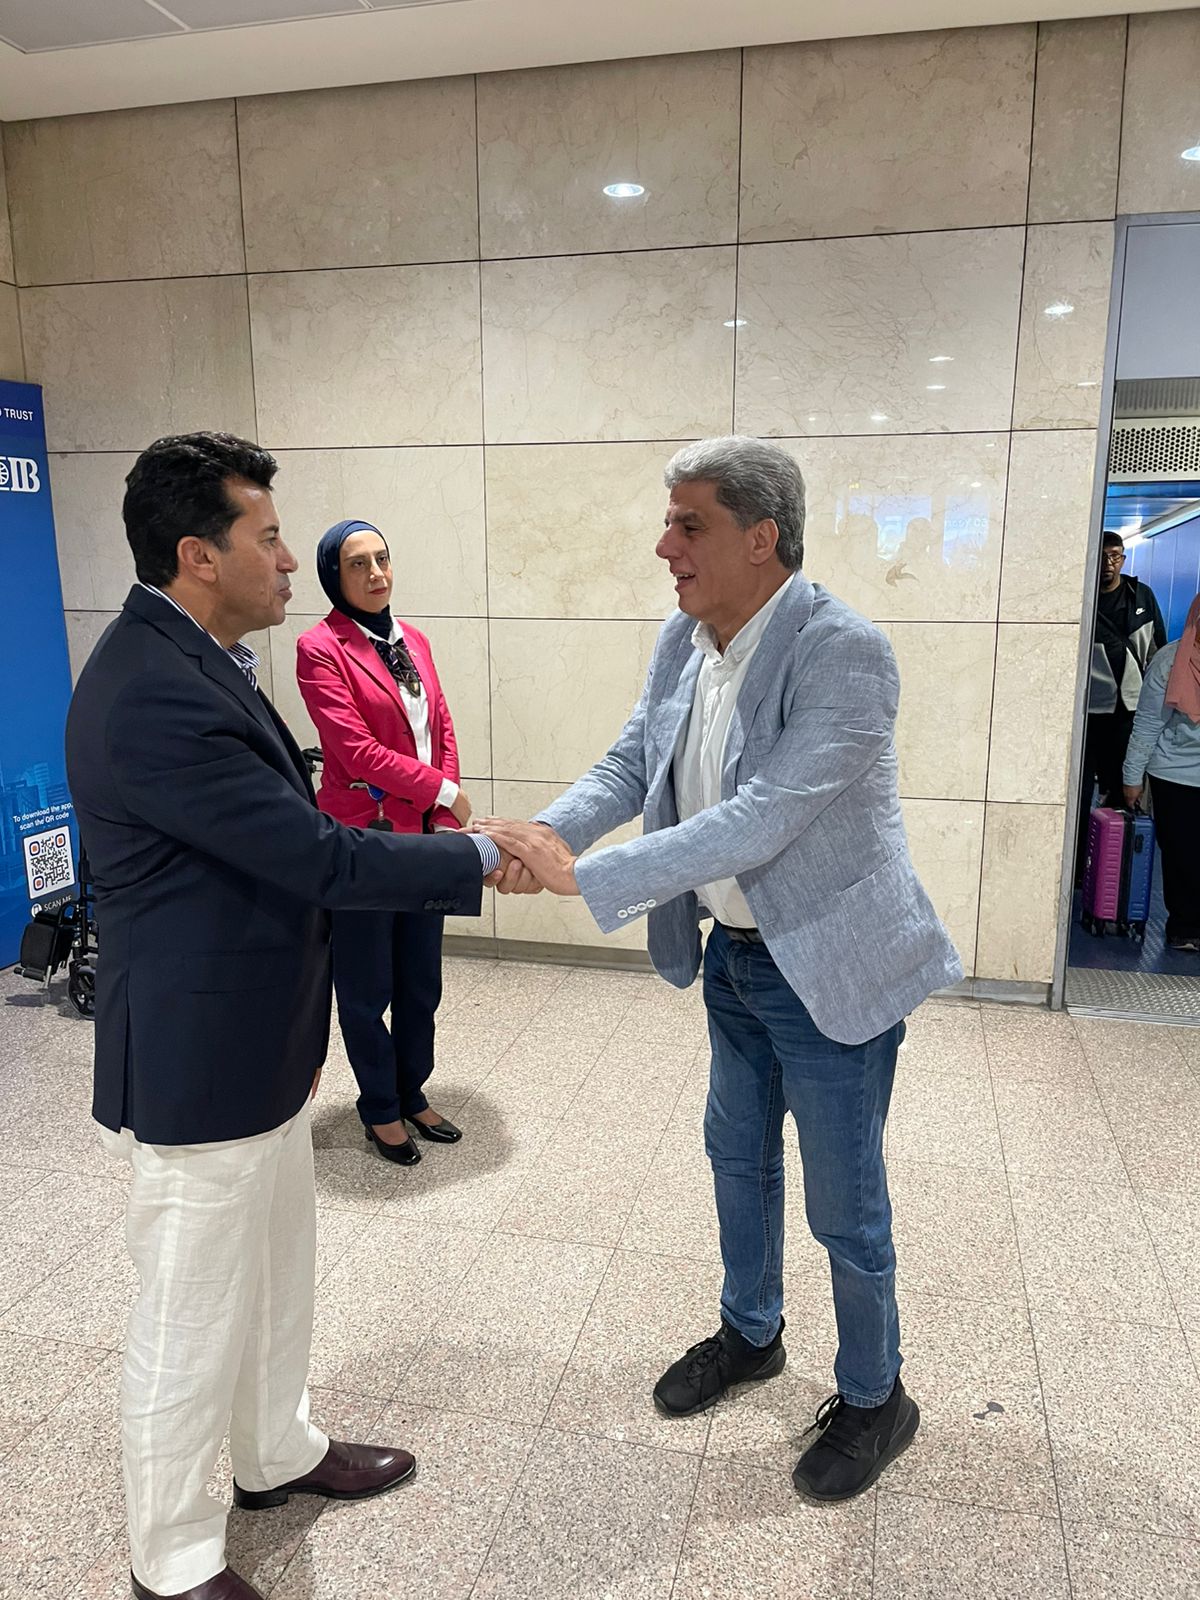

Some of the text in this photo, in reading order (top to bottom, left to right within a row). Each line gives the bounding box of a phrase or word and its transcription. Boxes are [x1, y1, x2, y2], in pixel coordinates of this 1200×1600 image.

[4, 408, 33, 421] TRUST
[21, 807, 50, 821] download
[51, 804, 60, 812] the
[19, 811, 69, 831] scan the QR code
[44, 898, 62, 912] SCAN
